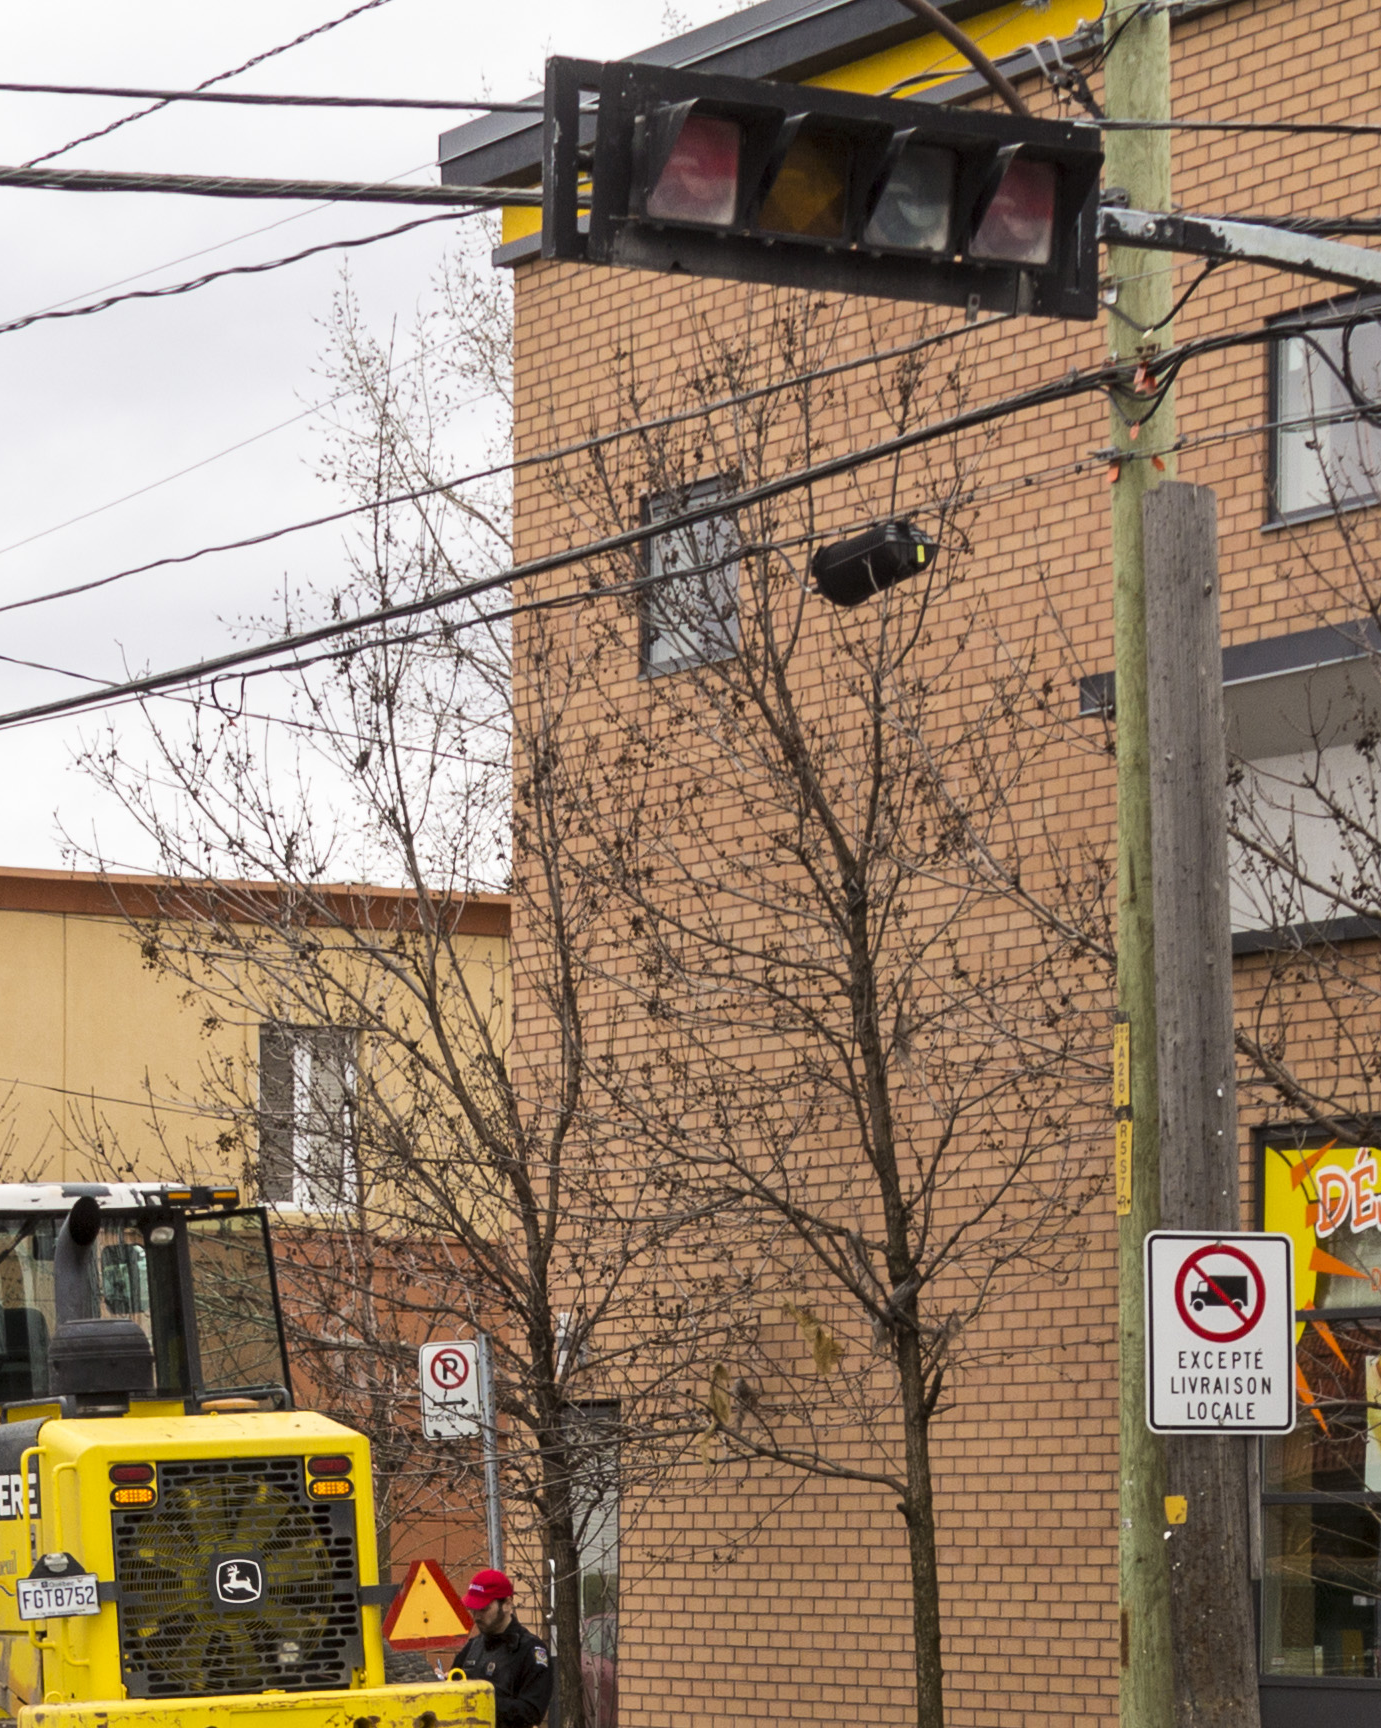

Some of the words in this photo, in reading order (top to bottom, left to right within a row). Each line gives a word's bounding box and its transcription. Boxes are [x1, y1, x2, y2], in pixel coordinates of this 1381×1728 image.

[1178, 1348, 1264, 1369] EXCEPTÉ
[1170, 1376, 1272, 1395] LIVRAISON
[1187, 1402, 1255, 1420] LOCALE
[22, 1586, 96, 1610] FGT8752
